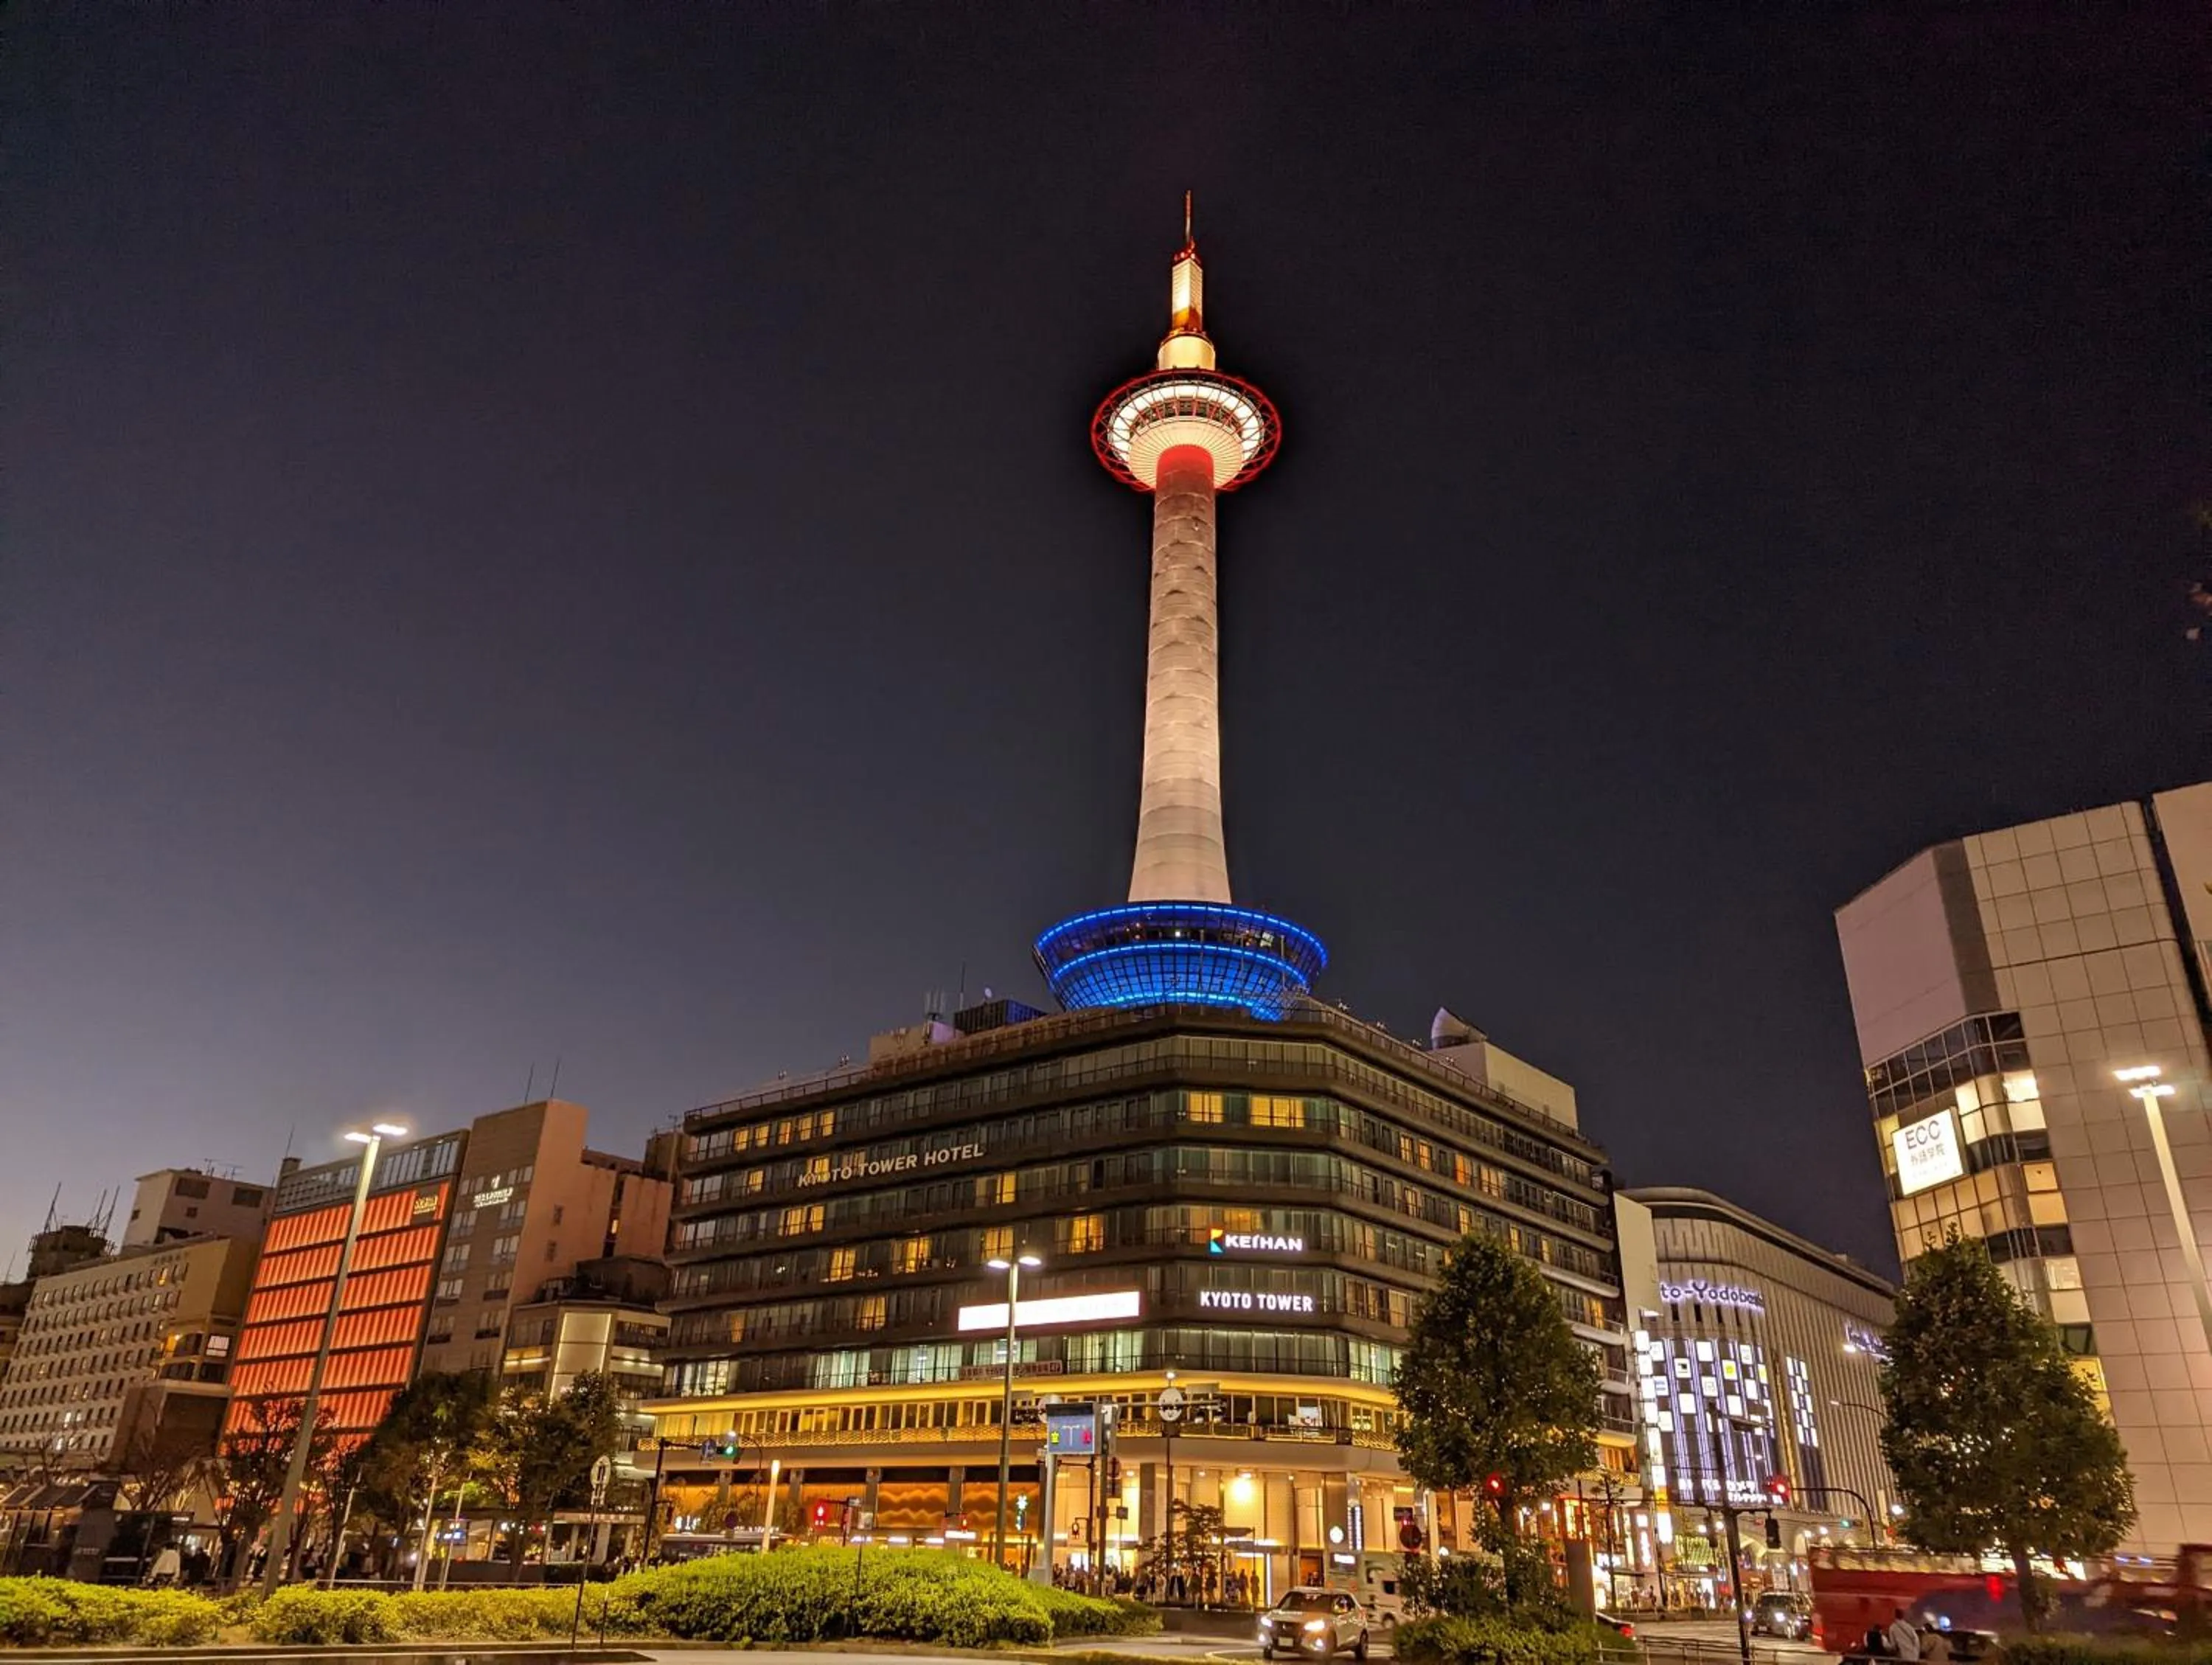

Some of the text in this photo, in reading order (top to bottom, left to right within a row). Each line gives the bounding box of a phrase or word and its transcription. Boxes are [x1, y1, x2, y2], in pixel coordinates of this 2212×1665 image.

[1905, 1119, 1941, 1150] ECC
[797, 1144, 985, 1188] KYOTO TOWER HOTEL
[1200, 1291, 1313, 1313] KYOTO TOWER
